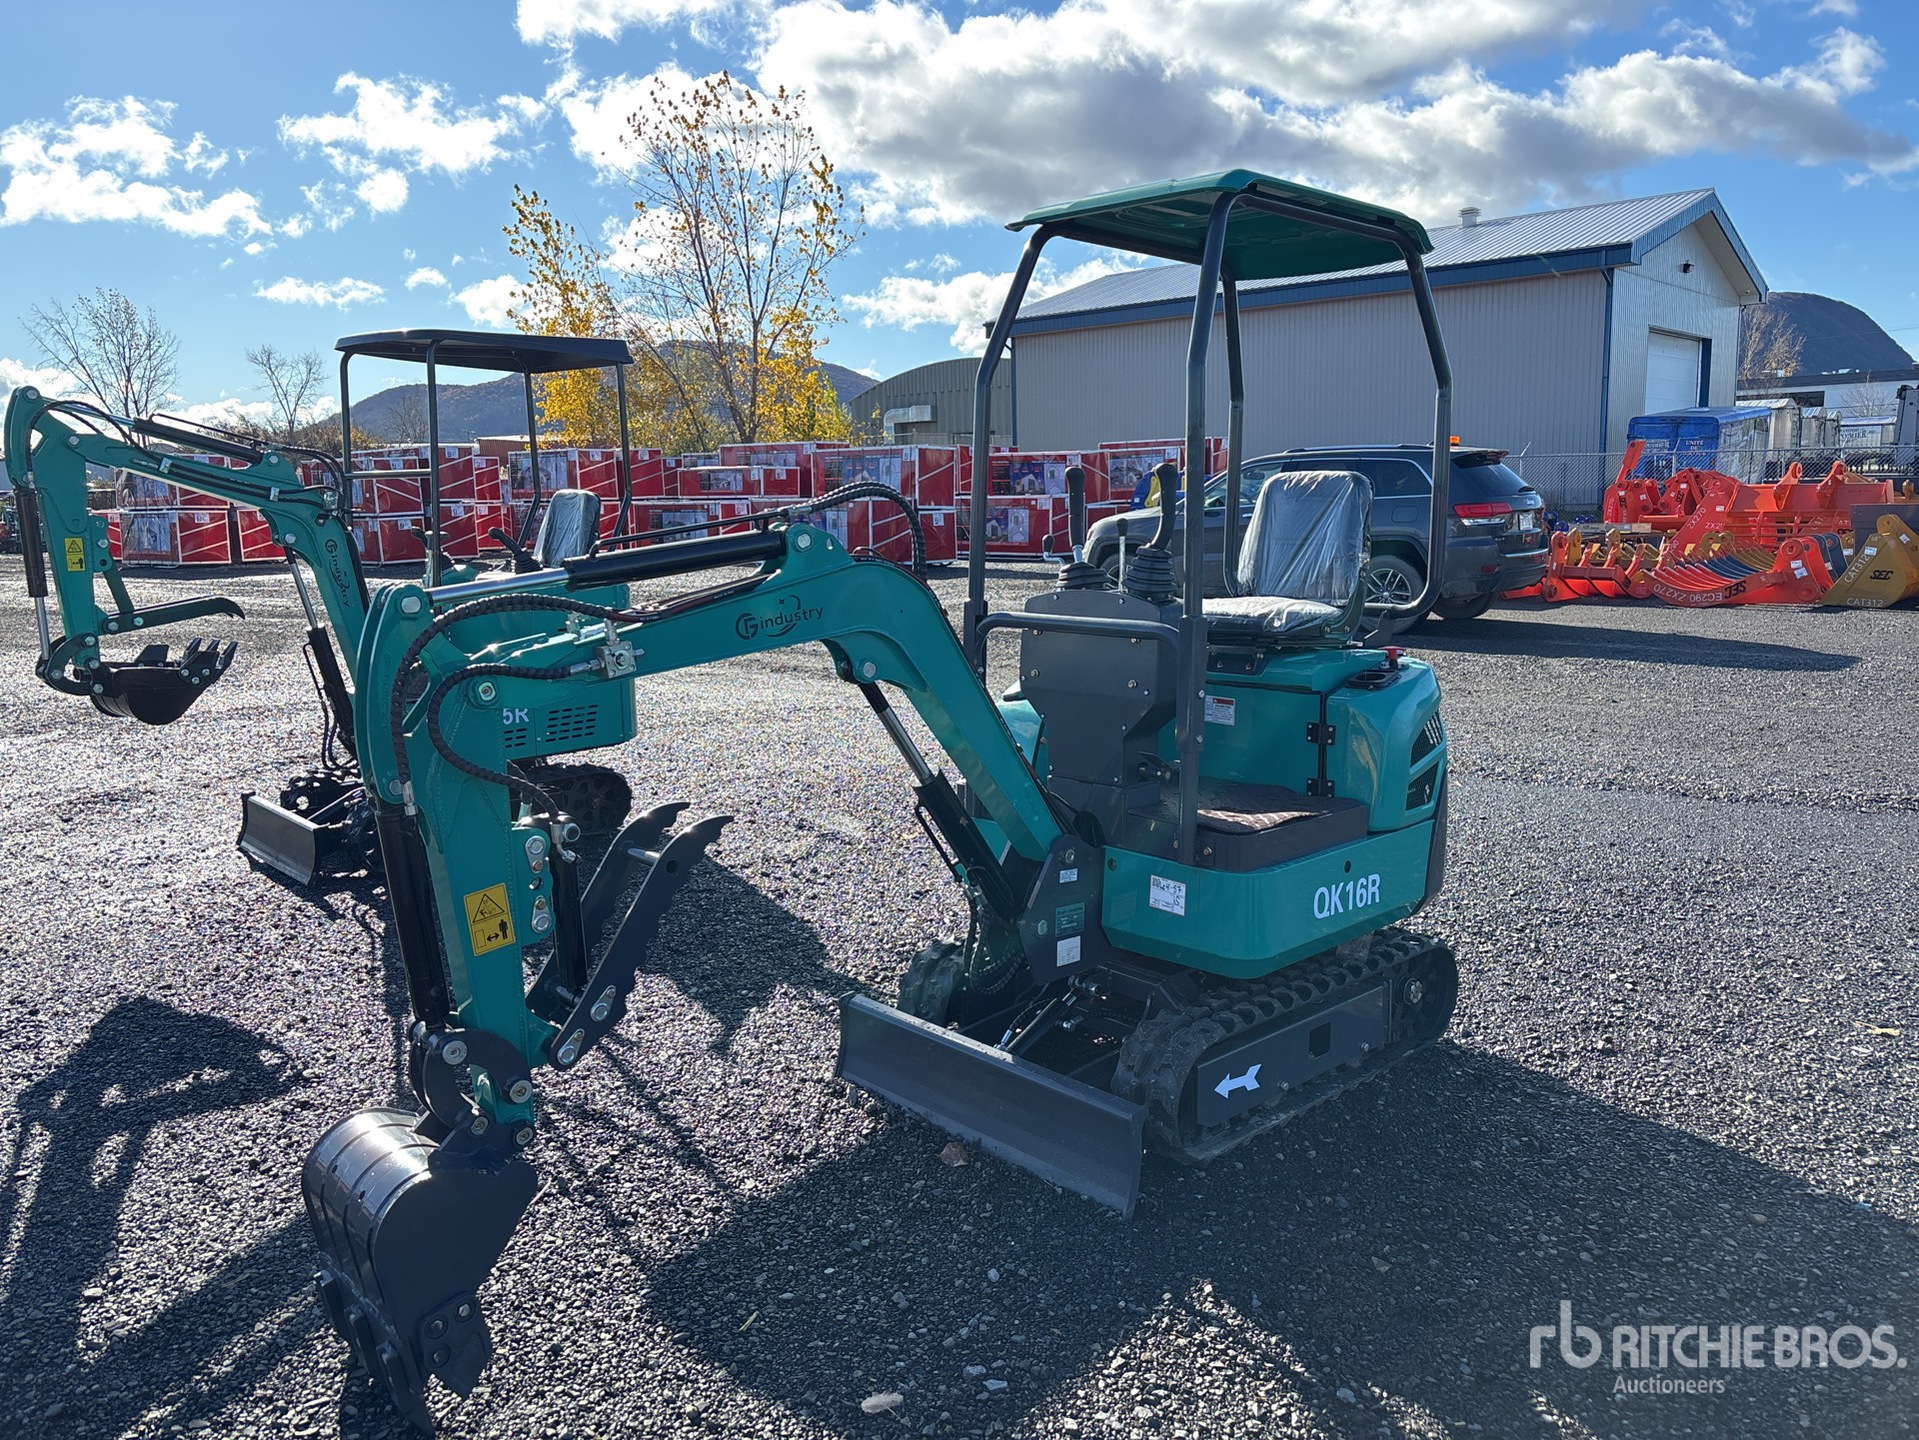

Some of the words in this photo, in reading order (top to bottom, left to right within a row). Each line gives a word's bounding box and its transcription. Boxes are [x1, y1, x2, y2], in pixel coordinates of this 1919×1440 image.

[1686, 507, 1707, 530] ZX270
[1844, 554, 1870, 583] CAT312
[1869, 569, 1894, 581] SEC
[1653, 583, 1687, 602] ZX270
[1689, 592, 1723, 603] EC290
[1724, 580, 1747, 599] SEC
[1846, 597, 1884, 608] CAT312
[1313, 873, 1380, 920] QK16R
